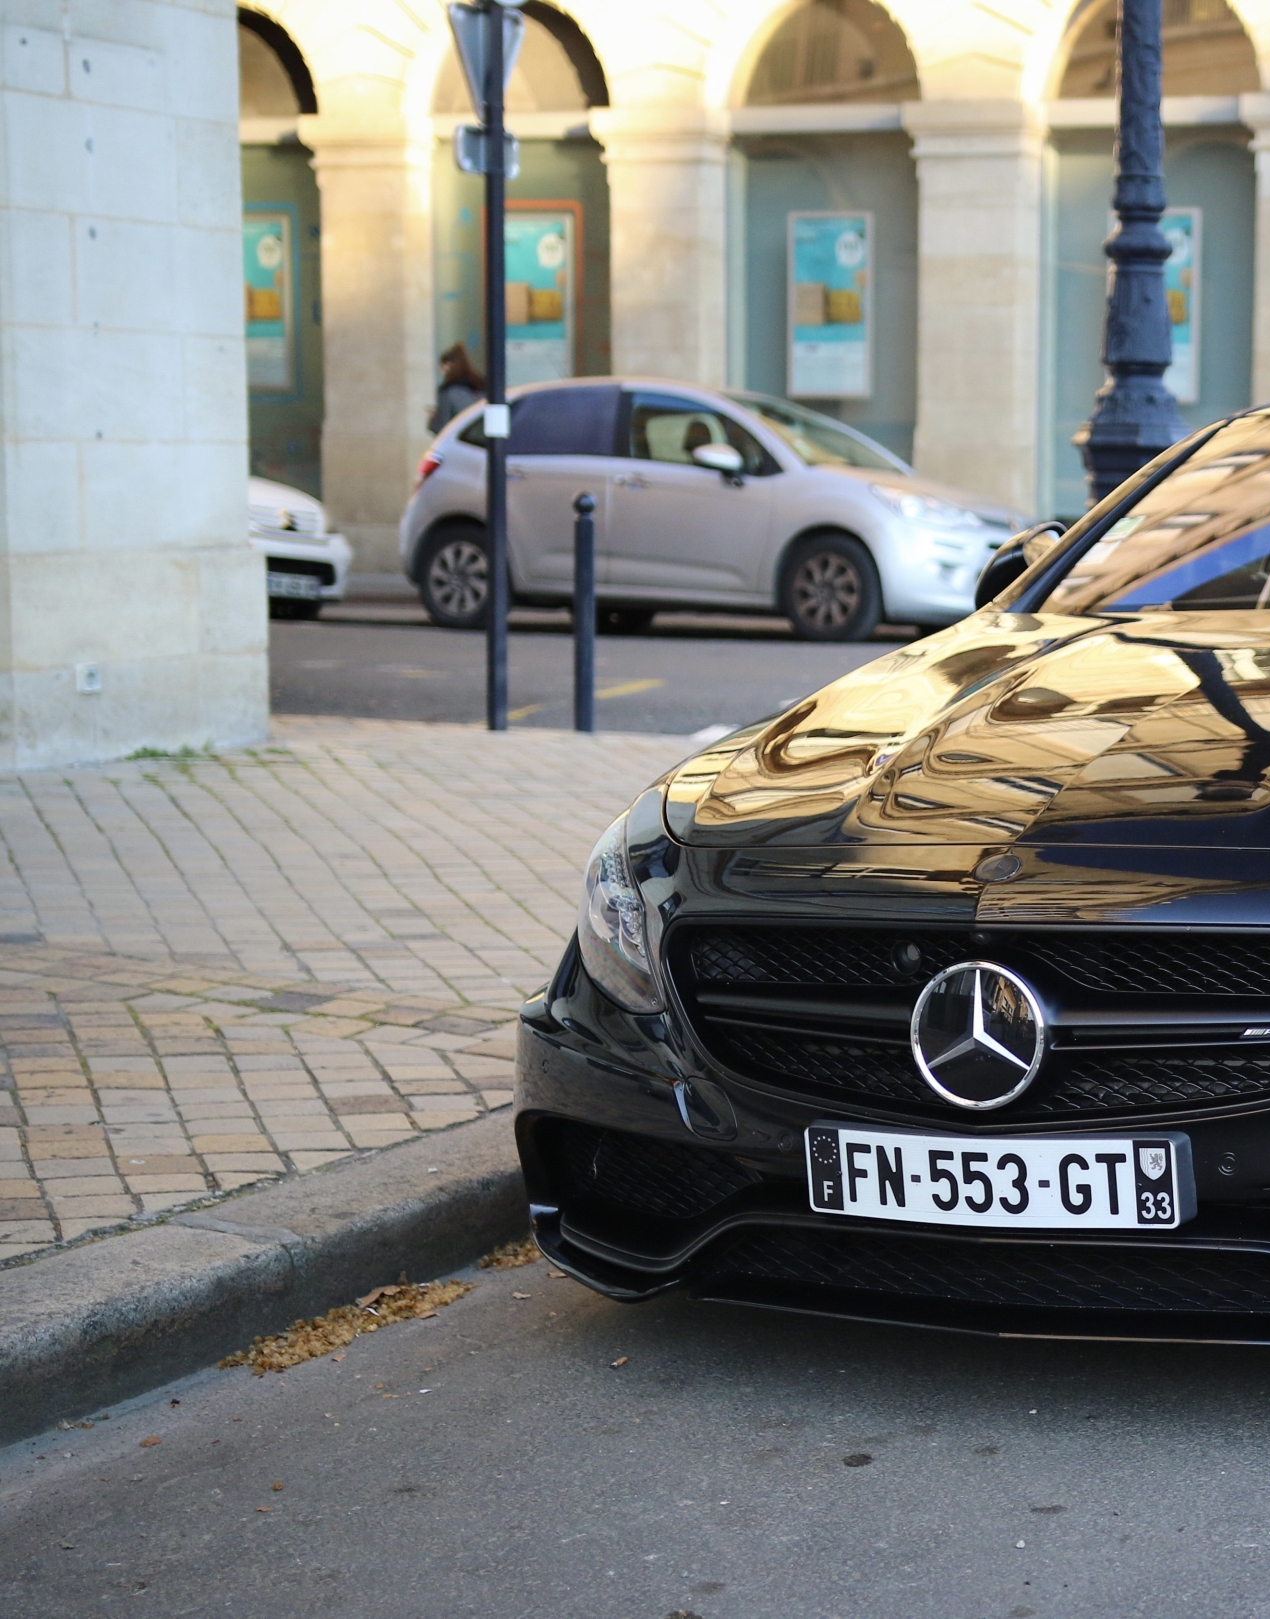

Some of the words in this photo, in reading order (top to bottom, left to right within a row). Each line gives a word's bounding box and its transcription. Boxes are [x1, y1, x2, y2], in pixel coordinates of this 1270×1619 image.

[822, 1180, 834, 1202] F
[846, 1142, 1127, 1215] FN-553-GT
[1141, 1191, 1172, 1219] 33
